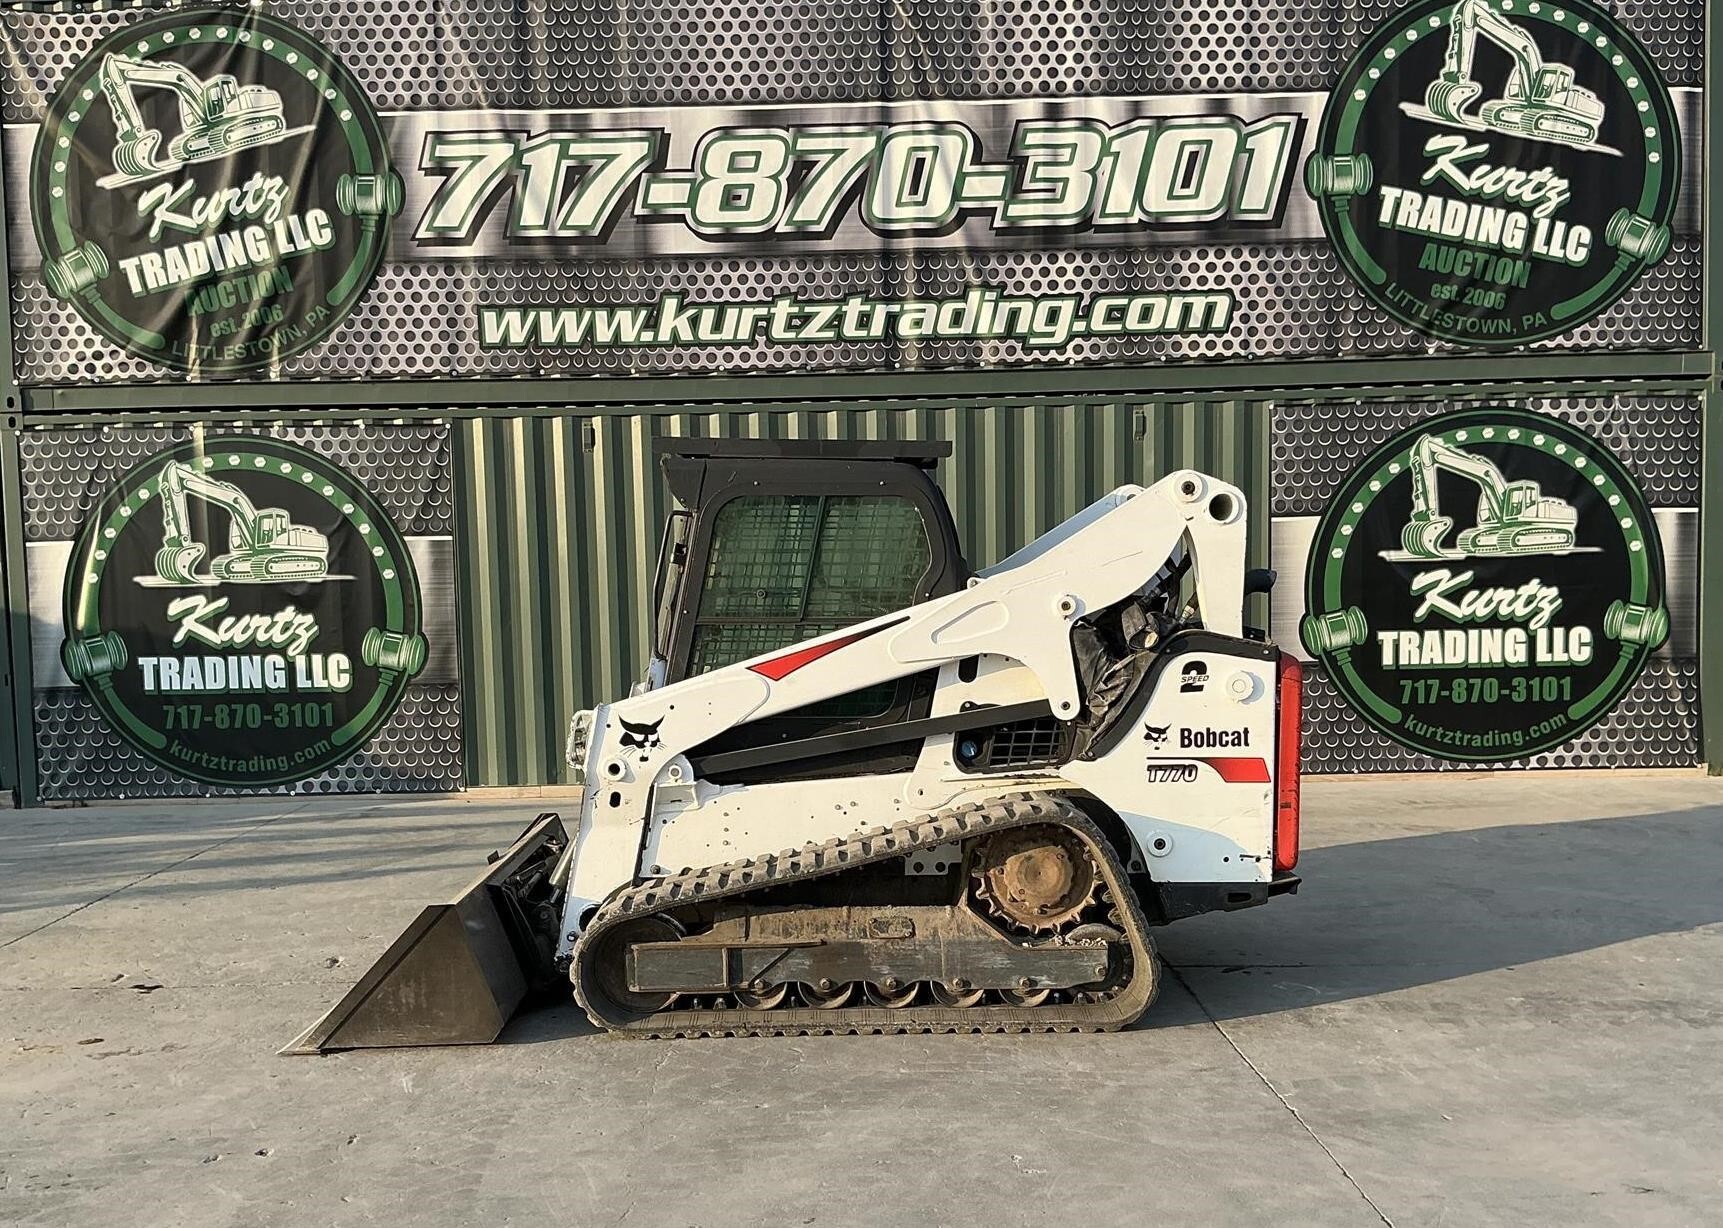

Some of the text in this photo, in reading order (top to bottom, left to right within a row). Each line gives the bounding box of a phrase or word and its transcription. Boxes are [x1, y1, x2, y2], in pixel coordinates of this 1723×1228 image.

[416, 115, 1302, 245] 717-870-3101
[1422, 134, 1570, 218] Kurtz
[138, 172, 289, 242] Kurtz
[1377, 185, 1592, 267] TRADING LLC
[119, 208, 335, 297] TRADING LLC
[1418, 244, 1531, 289] AUCTION
[188, 267, 293, 315] AUCTION
[1386, 284, 1548, 333] LITTLESTOWN, PA
[1463, 287, 1506, 311] 2006
[171, 306, 331, 361] LITTLESTOWN, PA
[242, 304, 284, 331] 2006
[478, 286, 1234, 350] www.kurtztrading.com
[1410, 569, 1562, 630] Kurtz
[167, 594, 319, 656] Kurtz
[1377, 626, 1593, 669] TRADING LLC
[138, 653, 353, 693] TRADING LLC
[1180, 661, 1208, 693] 2
[1180, 675, 1209, 683] SPEED
[1400, 676, 1571, 704] 717-870-3101
[162, 703, 333, 729] 717-870-3101
[1180, 727, 1249, 748] Bobcat
[1405, 713, 1567, 747] kurtztrading.com
[170, 739, 331, 773] kurtztrading.com
[1147, 764, 1197, 782] T770
